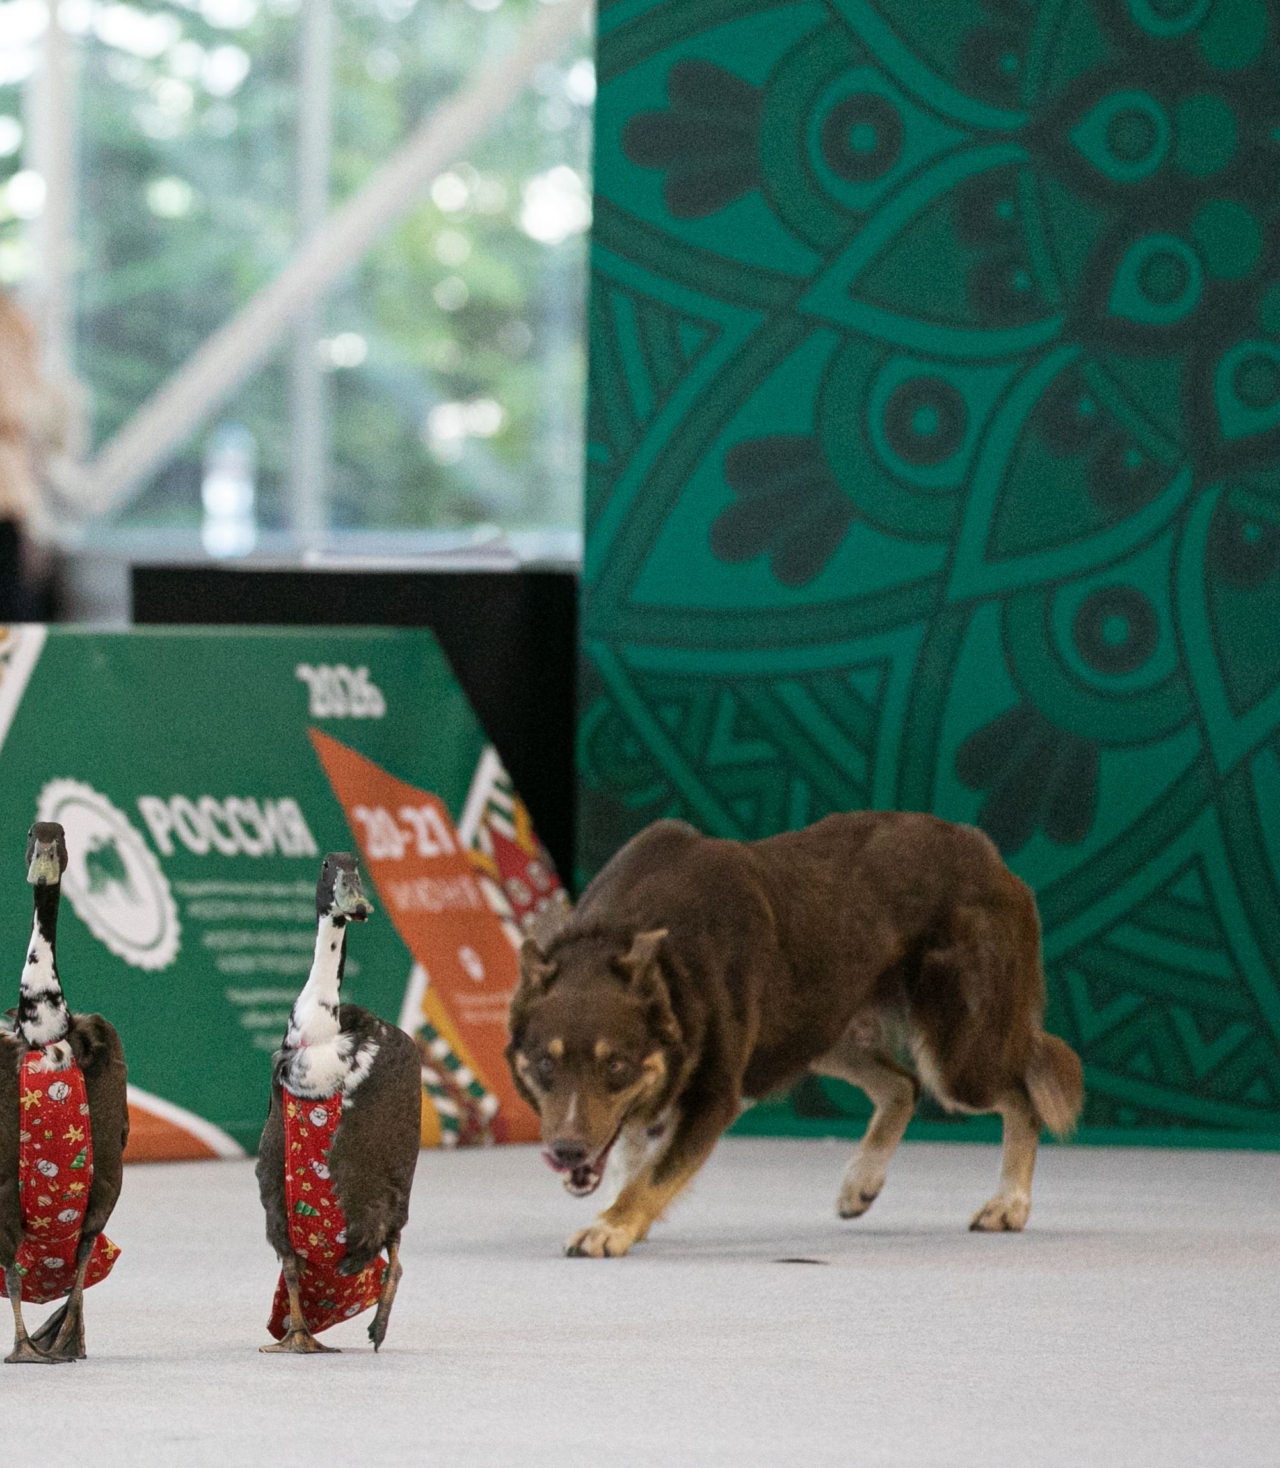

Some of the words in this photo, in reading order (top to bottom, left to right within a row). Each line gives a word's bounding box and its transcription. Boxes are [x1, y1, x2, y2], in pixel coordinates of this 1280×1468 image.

[295, 663, 386, 719] 2026
[137, 795, 319, 858] РОССИЯ
[352, 804, 457, 859] 20-21
